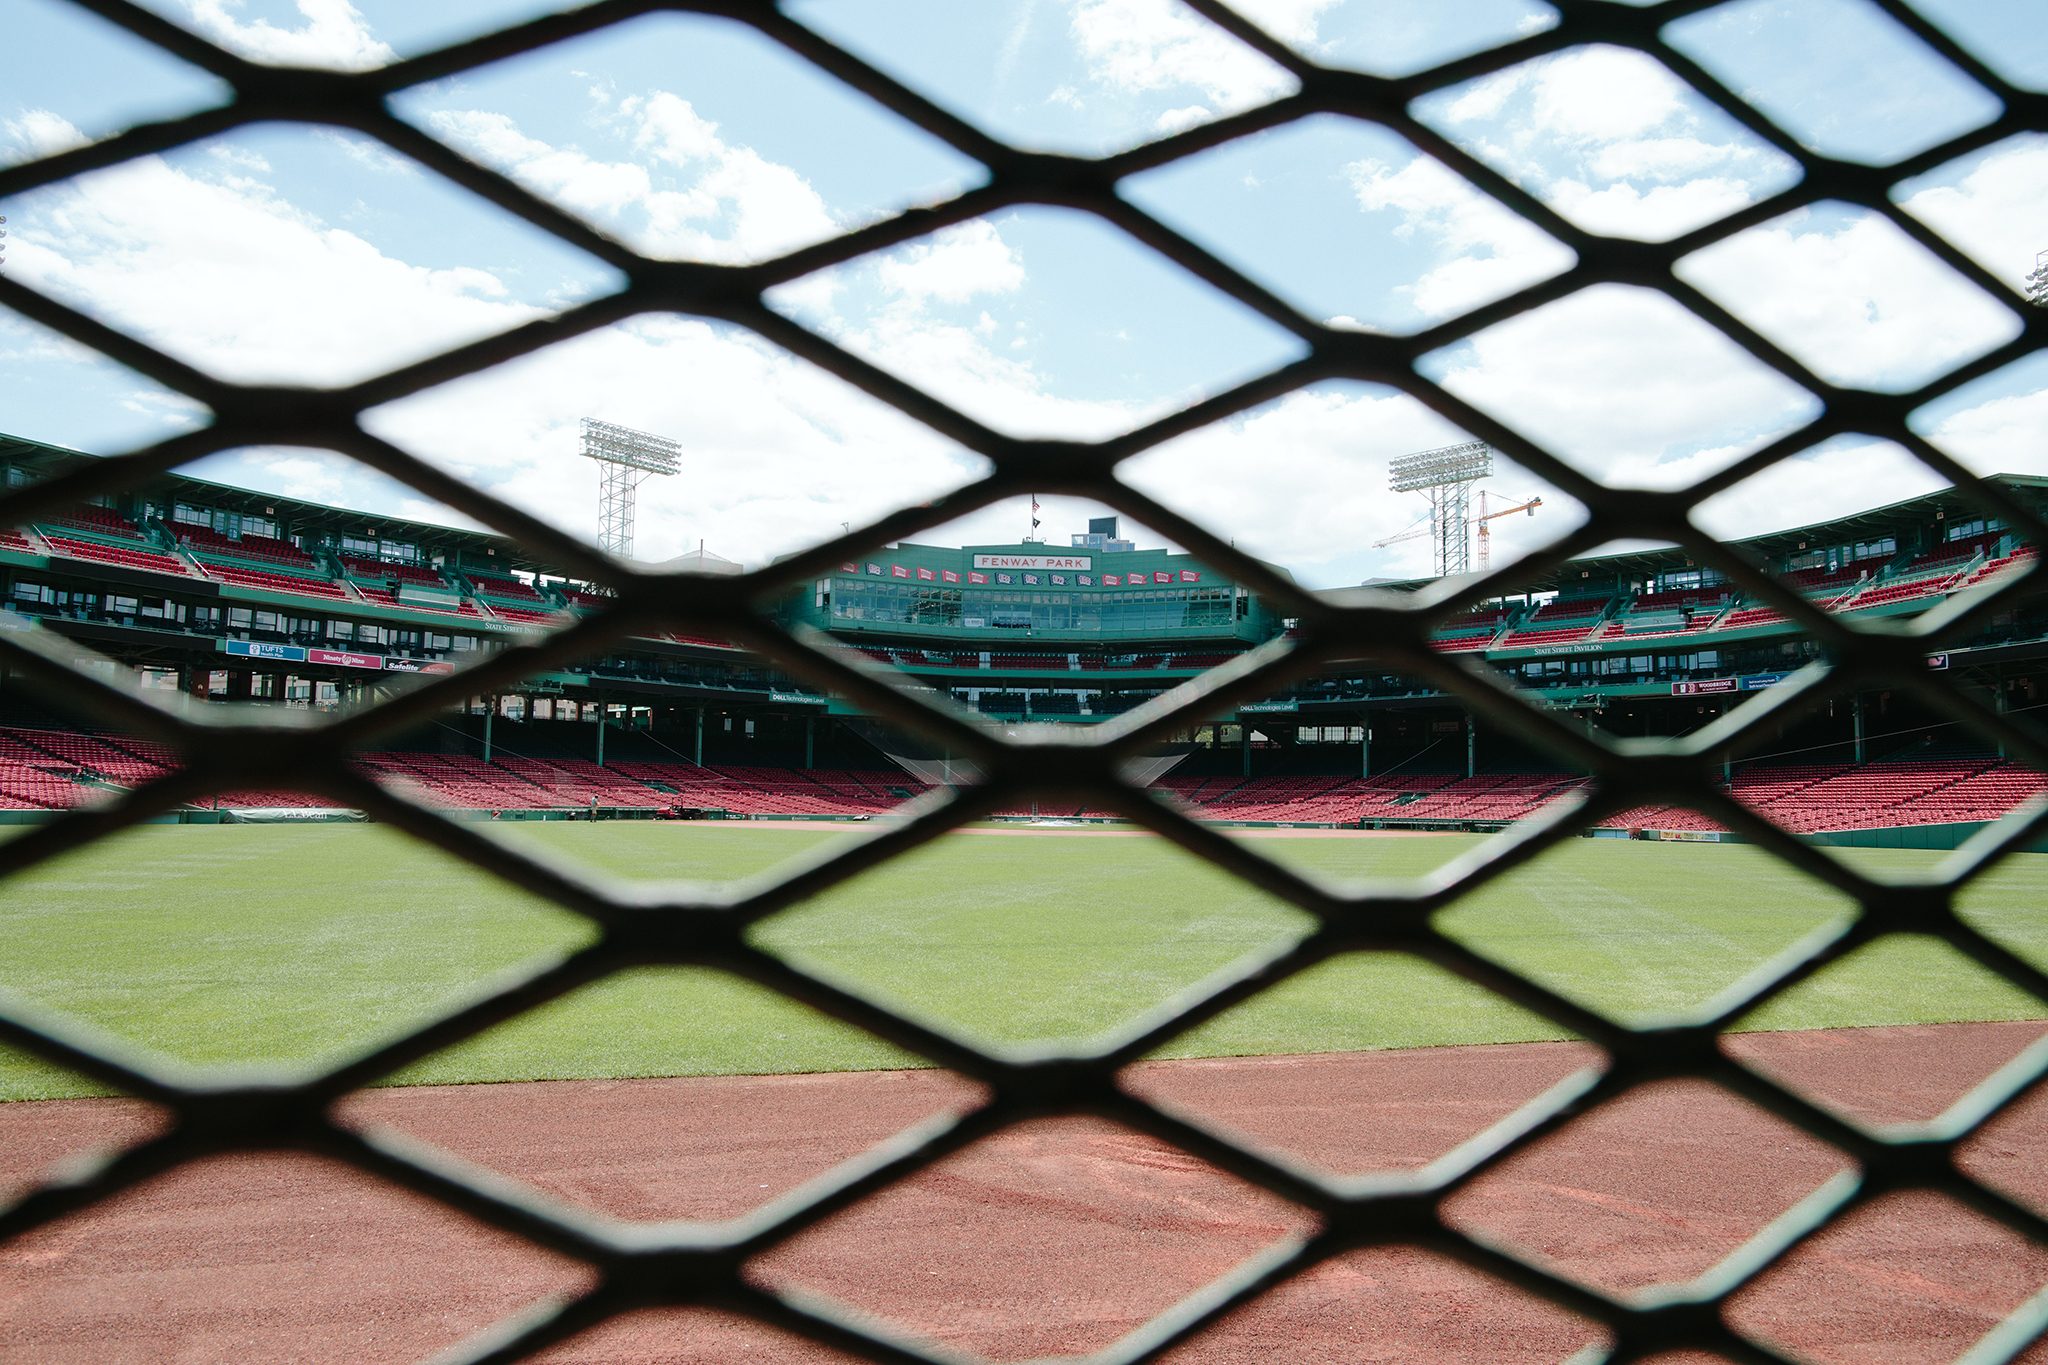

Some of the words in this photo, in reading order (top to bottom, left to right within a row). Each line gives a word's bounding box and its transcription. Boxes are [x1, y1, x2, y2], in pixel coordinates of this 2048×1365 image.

[982, 557, 1037, 566] FENWAY
[1046, 559, 1083, 568] PARK
[485, 622, 502, 631] STATE
[261, 645, 284, 653] TUFTS
[1573, 644, 1603, 652] PAVILION
[323, 654, 342, 662] Ninety
[351, 657, 365, 665] Nine
[388, 662, 419, 671] Safelite
[1699, 680, 1732, 688] WOODBRIDGE
